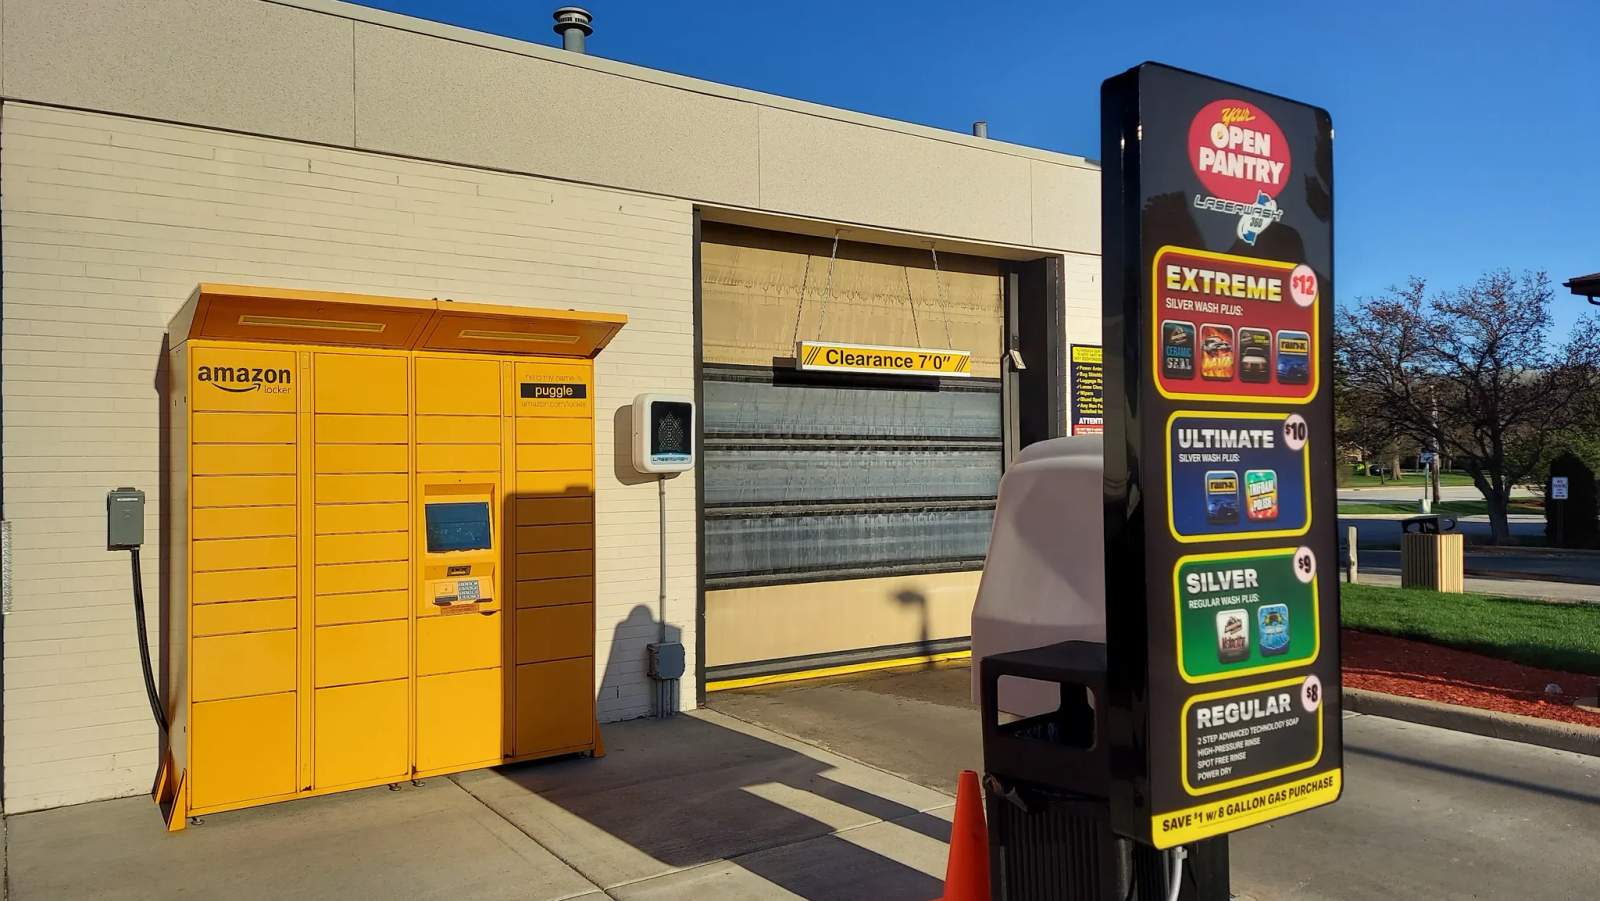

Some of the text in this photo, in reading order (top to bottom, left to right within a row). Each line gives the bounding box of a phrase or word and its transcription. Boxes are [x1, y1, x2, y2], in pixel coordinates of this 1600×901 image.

[1210, 122, 1270, 157] OPEN
[1200, 146, 1284, 184] PANTRY
[1194, 194, 1283, 220] LASERWASH
[1166, 264, 1282, 302] EXTREME
[1292, 274, 1314, 296] $12
[1166, 298, 1244, 316] SILVER WASH PLUS:
[826, 350, 913, 368] Clearance
[198, 366, 291, 384] amazon
[264, 386, 292, 394] locker
[535, 384, 574, 398] puggle
[1178, 428, 1274, 448] ULTIMATE
[1286, 422, 1306, 440] $10
[1178, 454, 1240, 462] SILVER WASH PLUS:
[1298, 555, 1312, 574] $9
[1186, 568, 1258, 594] SILVER
[1188, 597, 1220, 609] REGULAR
[1221, 595, 1241, 606] WASH
[1306, 684, 1318, 702] $8
[1197, 693, 1292, 729] REGULAR
[1203, 734, 1218, 744] STEP
[1219, 728, 1249, 741] ADVANCED
[1250, 720, 1285, 735] TECHNOLOGY
[1285, 717, 1299, 727] SOAP
[1198, 737, 1260, 757] HIGH-PRESSURE RINSE
[1198, 751, 1246, 768] SPOT FREE RINSE
[1198, 766, 1232, 780] POWER DRY
[1162, 814, 1192, 832] SAVE
[1194, 811, 1203, 824] $1
[1218, 807, 1224, 818] 8
[1226, 795, 1266, 816] GALLON
[1268, 790, 1287, 805] GAS
[1288, 776, 1333, 798] PURCHASE
